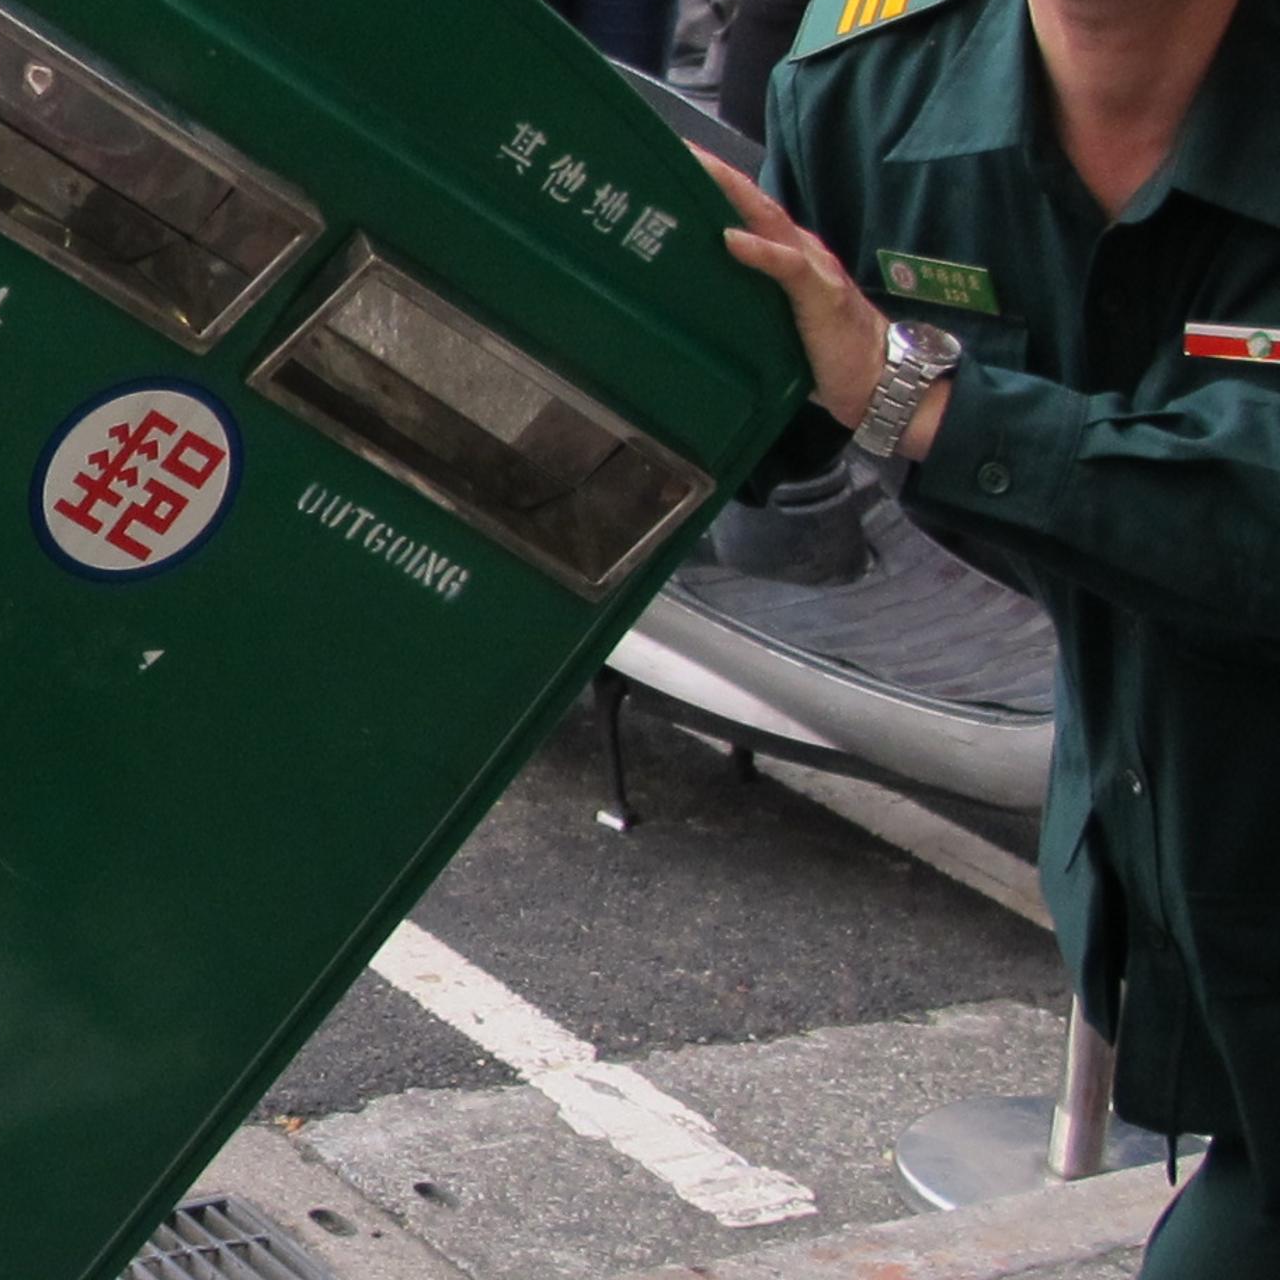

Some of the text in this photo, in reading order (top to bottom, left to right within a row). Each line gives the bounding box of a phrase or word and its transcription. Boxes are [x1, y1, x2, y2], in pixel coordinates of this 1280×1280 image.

[496, 123, 679, 263] 其他地區
[297, 482, 472, 602] OUTGOING
